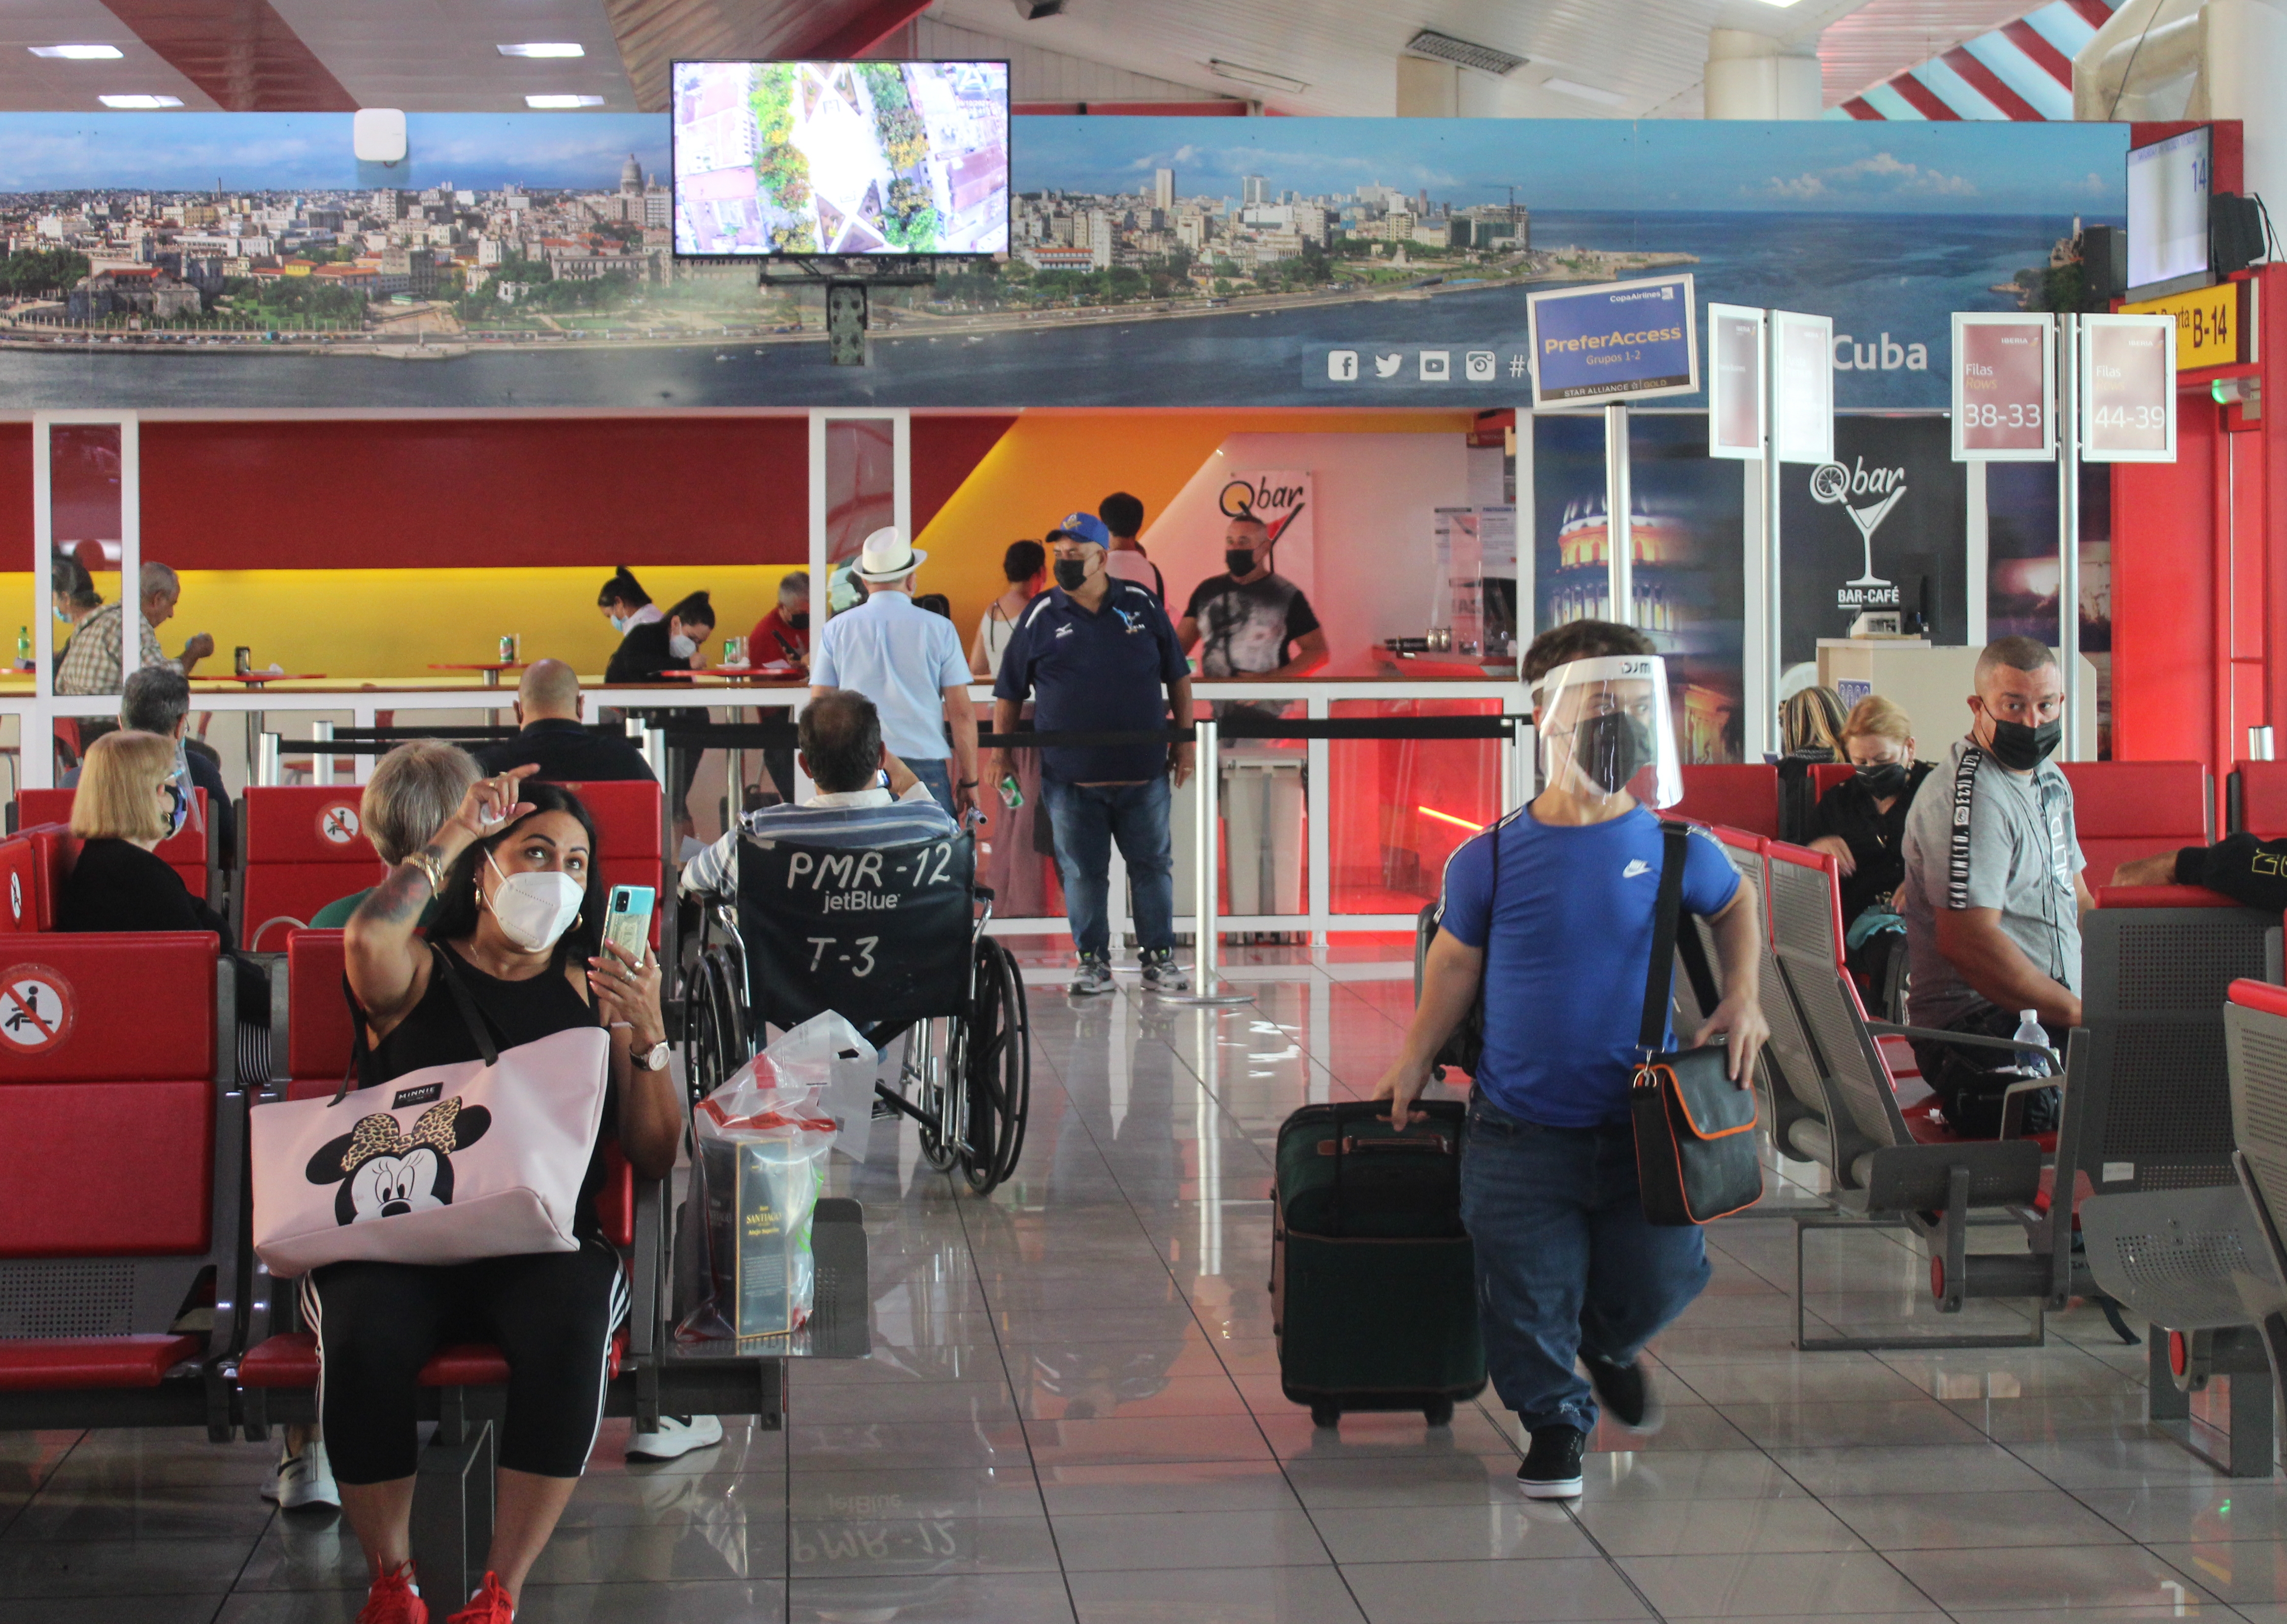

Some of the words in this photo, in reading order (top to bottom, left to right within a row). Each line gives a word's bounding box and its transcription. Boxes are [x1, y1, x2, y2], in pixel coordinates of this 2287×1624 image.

[2191, 157, 2207, 192] 14
[1610, 290, 1661, 303] CopaAirlines
[2193, 304, 2227, 348] B-14
[1545, 326, 1682, 355] PreferAccess
[1832, 332, 1927, 370] Cuba
[1586, 352, 1622, 366] Grupos
[1625, 350, 1641, 361] 1-2
[1965, 364, 1993, 375] Filas
[2096, 366, 2121, 377] Filas
[1564, 388, 1585, 398] STAR
[1587, 383, 1628, 395] ALLIANCE
[1643, 379, 1667, 387] GOLD
[1965, 378, 1998, 390] Rows
[1964, 403, 2041, 428] 38-33
[2094, 405, 2165, 428] 44-39
[1838, 585, 1900, 604] BAR-CAFÉ
[822, 890, 899, 914] jetBlue
[807, 936, 879, 978] T-3
[398, 1086, 436, 1100] MINNIE
